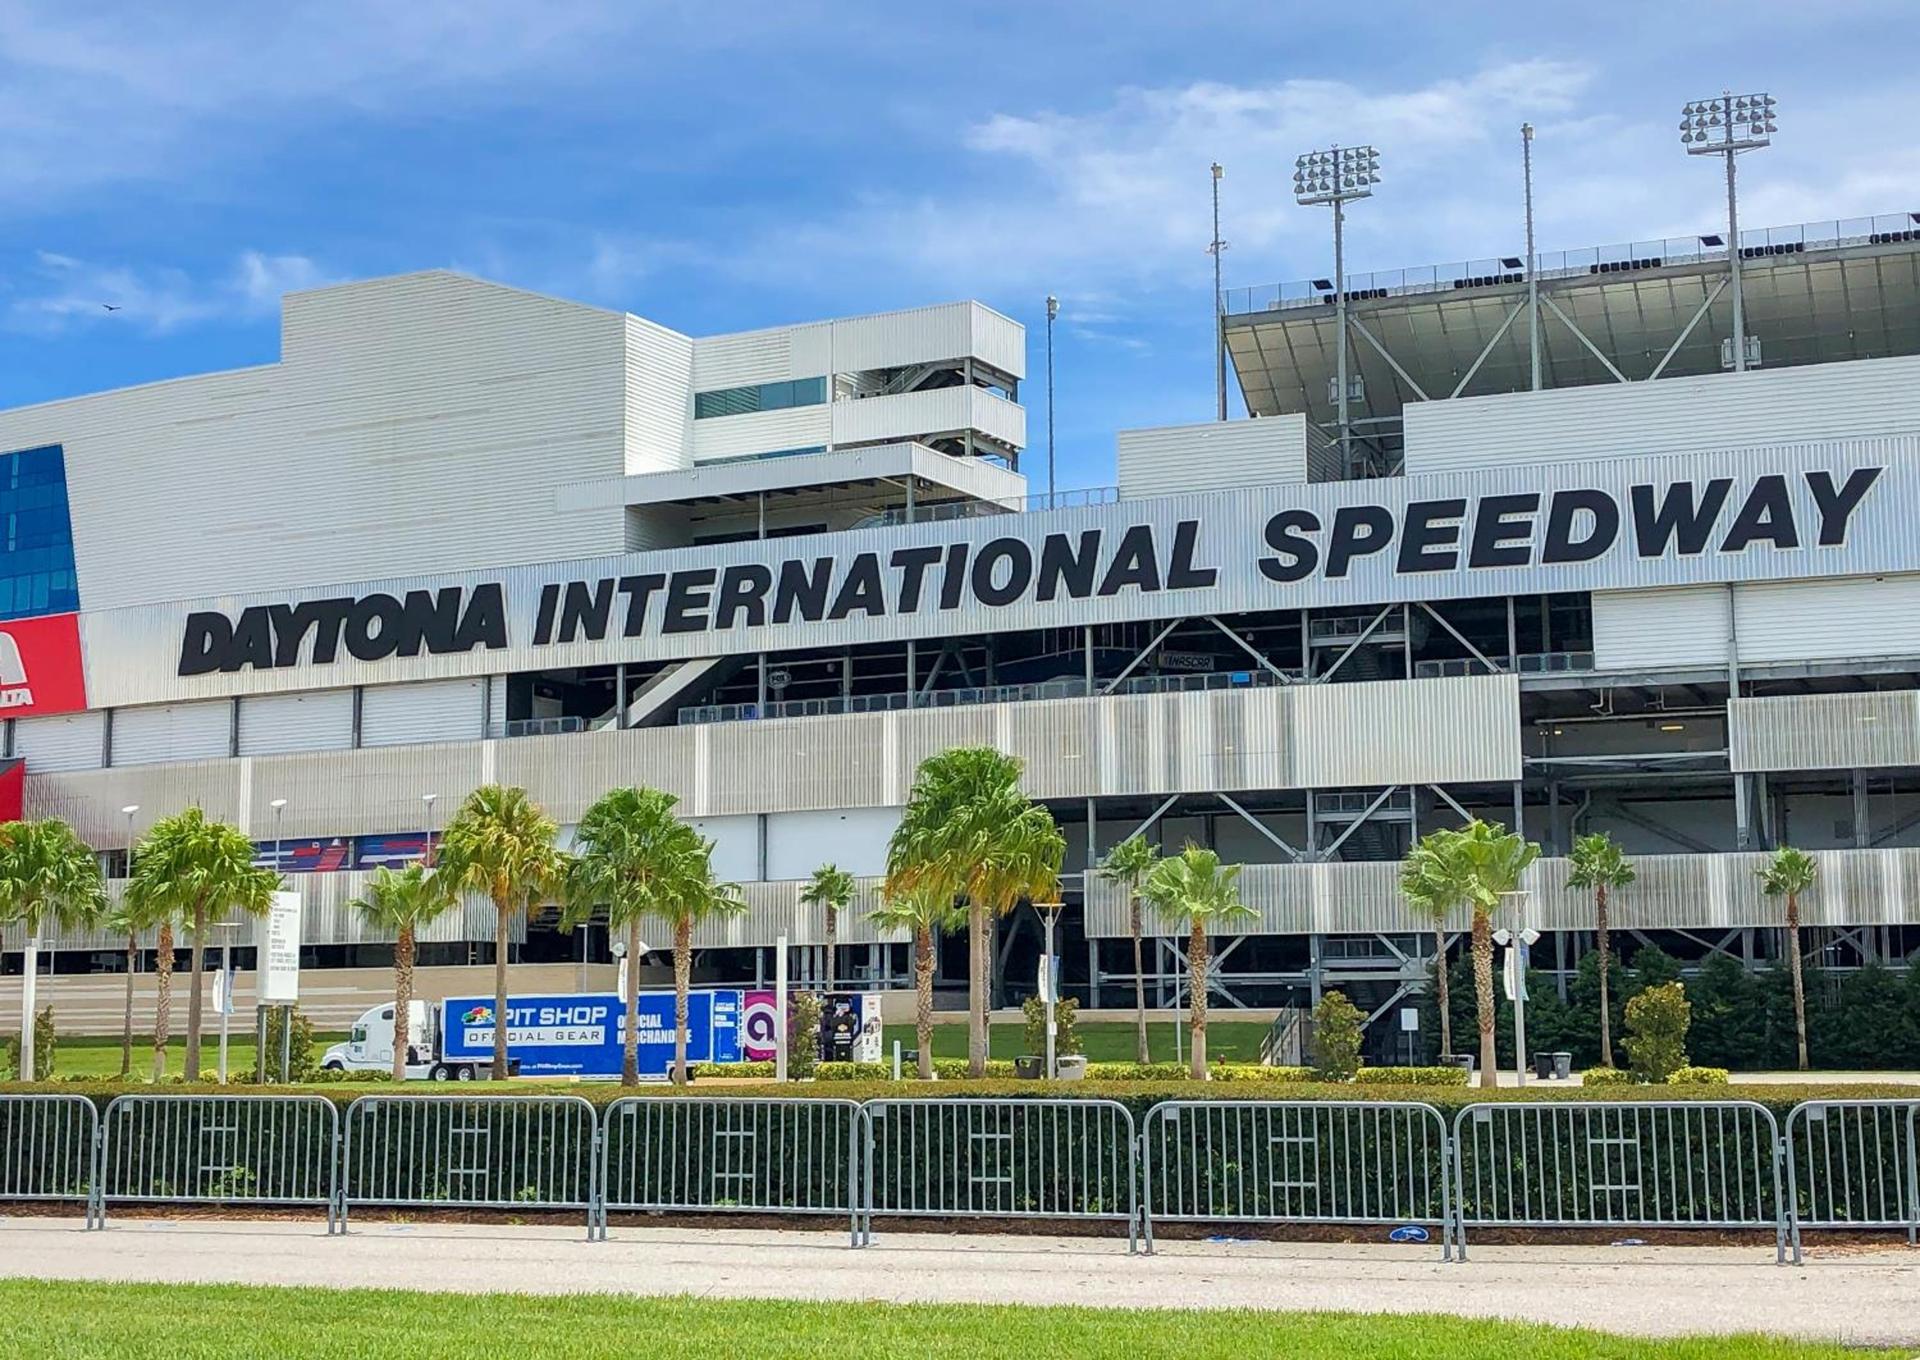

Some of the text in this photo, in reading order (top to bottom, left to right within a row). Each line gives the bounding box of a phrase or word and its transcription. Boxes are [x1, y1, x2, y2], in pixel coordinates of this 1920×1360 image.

[178, 467, 1885, 676] DAYTONA INTERNATIONAL SPEEDWAY
[539, 1007, 607, 1025] SHOP
[617, 1014, 663, 1028] OCIAL
[469, 1031, 600, 1041] OFFCIAL GEAR
[617, 1029, 692, 1044] MCHANDE
